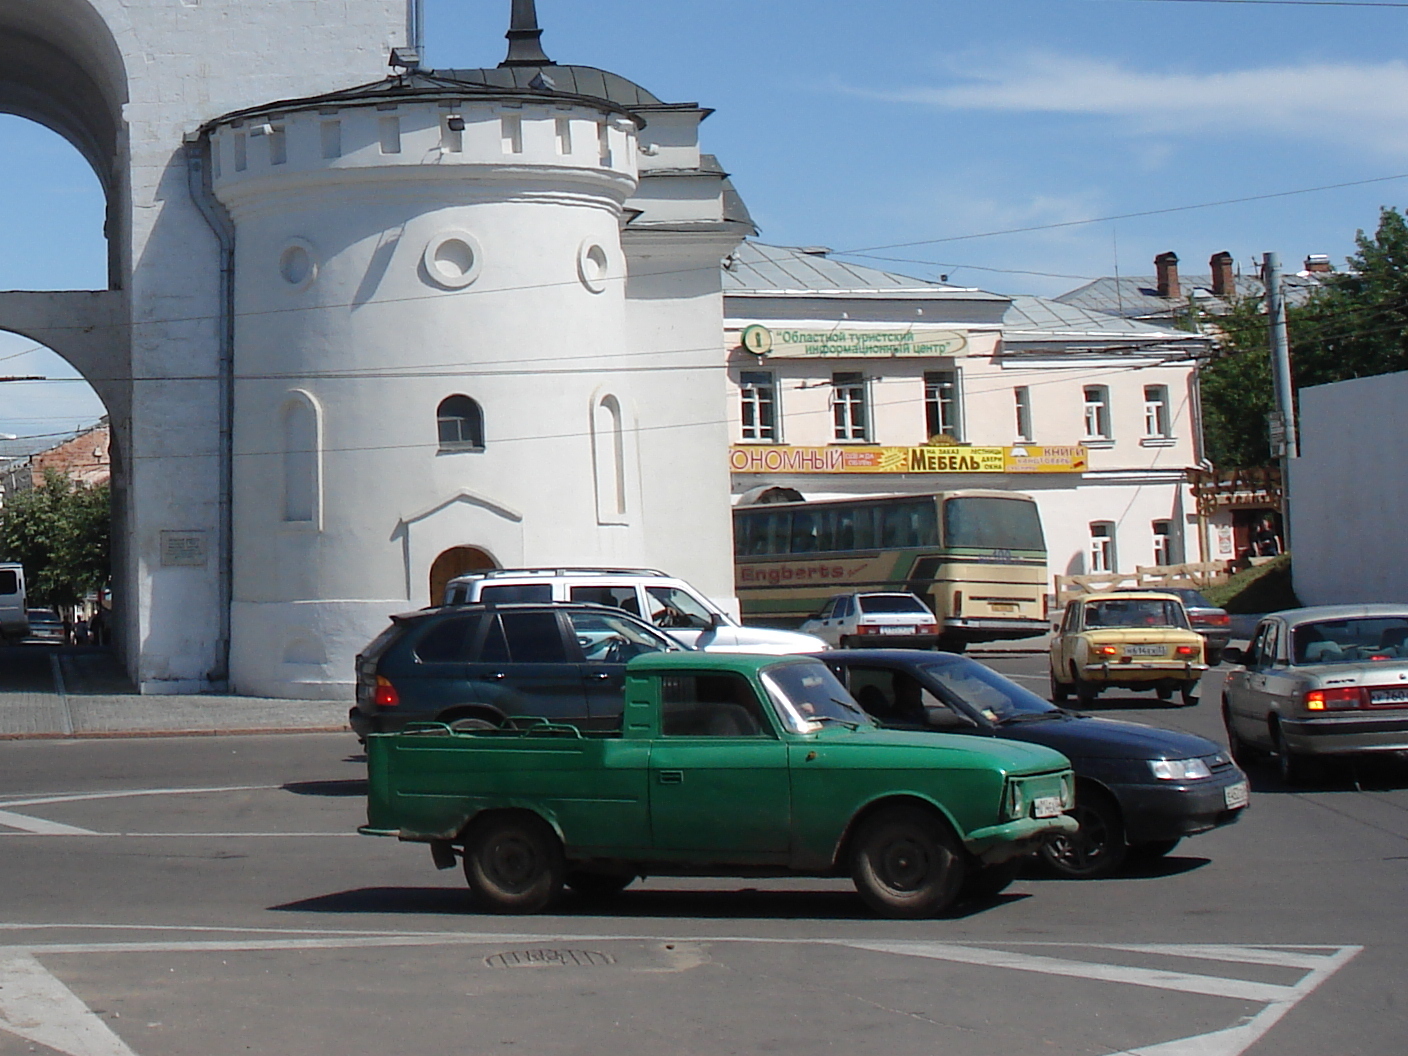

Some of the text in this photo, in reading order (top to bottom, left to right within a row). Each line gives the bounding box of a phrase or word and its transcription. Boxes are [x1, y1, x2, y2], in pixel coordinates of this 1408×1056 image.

[805, 341, 911, 356] информационный
[729, 449, 844, 470] ОНОМНЫЙ
[1044, 447, 1085, 457] КНИГИ
[742, 564, 844, 584] Engberts
